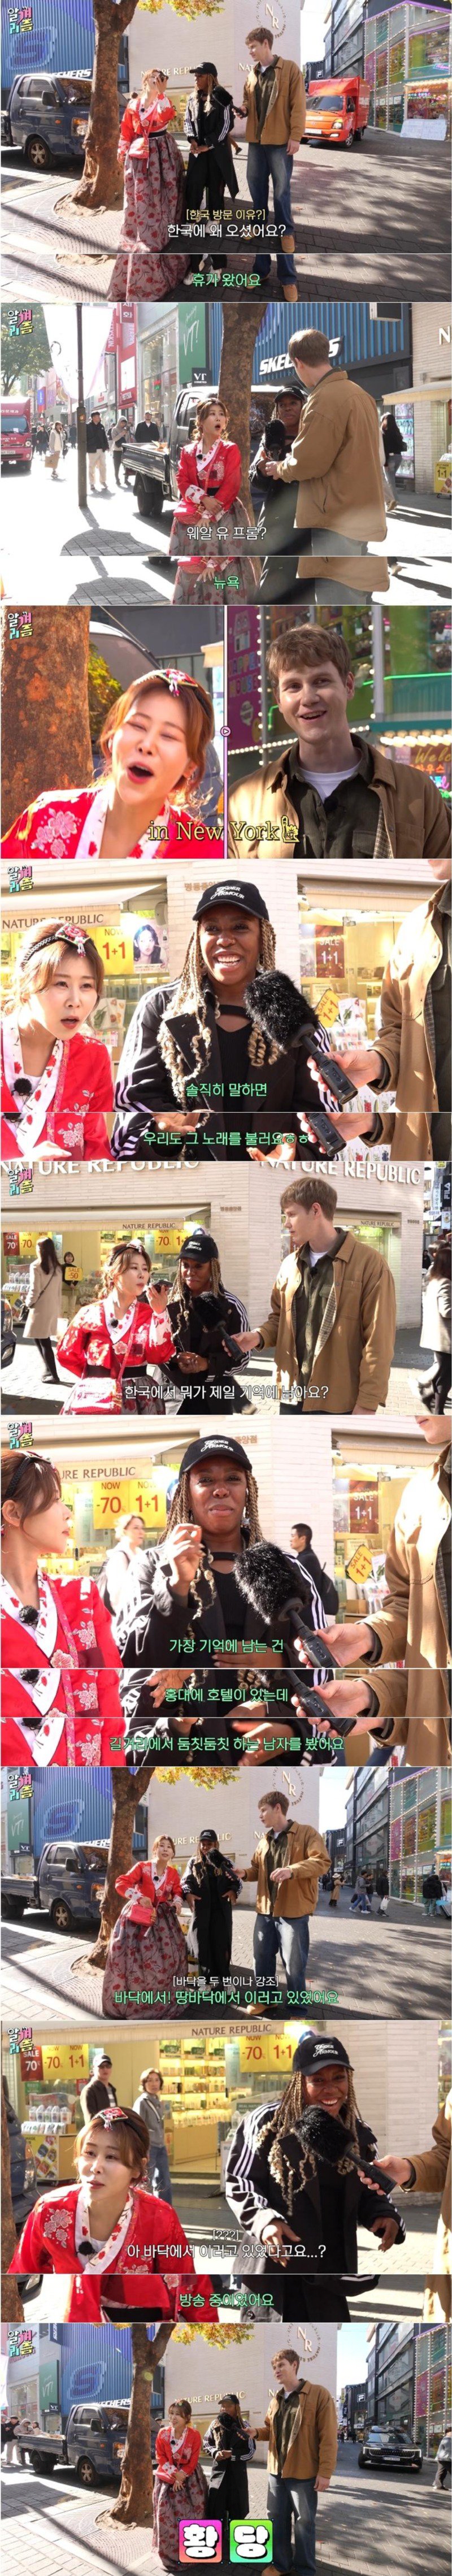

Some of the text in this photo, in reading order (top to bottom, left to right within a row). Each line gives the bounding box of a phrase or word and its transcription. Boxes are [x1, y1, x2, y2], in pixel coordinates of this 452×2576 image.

[259, 337, 341, 376] SKECS
[437, 470, 447, 478] 1+1
[102, 942, 126, 960] 1+1
[321, 951, 338, 965] 1+1
[318, 995, 329, 1012] SALE
[323, 1000, 338, 1021] 1+1
[344, 1161, 421, 1185] REPUBLIC
[83, 1467, 136, 1478] REPUBLIC
[136, 1495, 159, 1512] 1+1
[355, 1506, 372, 1520] 1+1
[350, 1551, 362, 1569] SALE
[356, 1556, 371, 1577] 1+1
[192, 2024, 271, 2036] NATURE REPUBLIC
[273, 2044, 292, 2060] 1+1
[69, 2054, 84, 2068] 1+1
